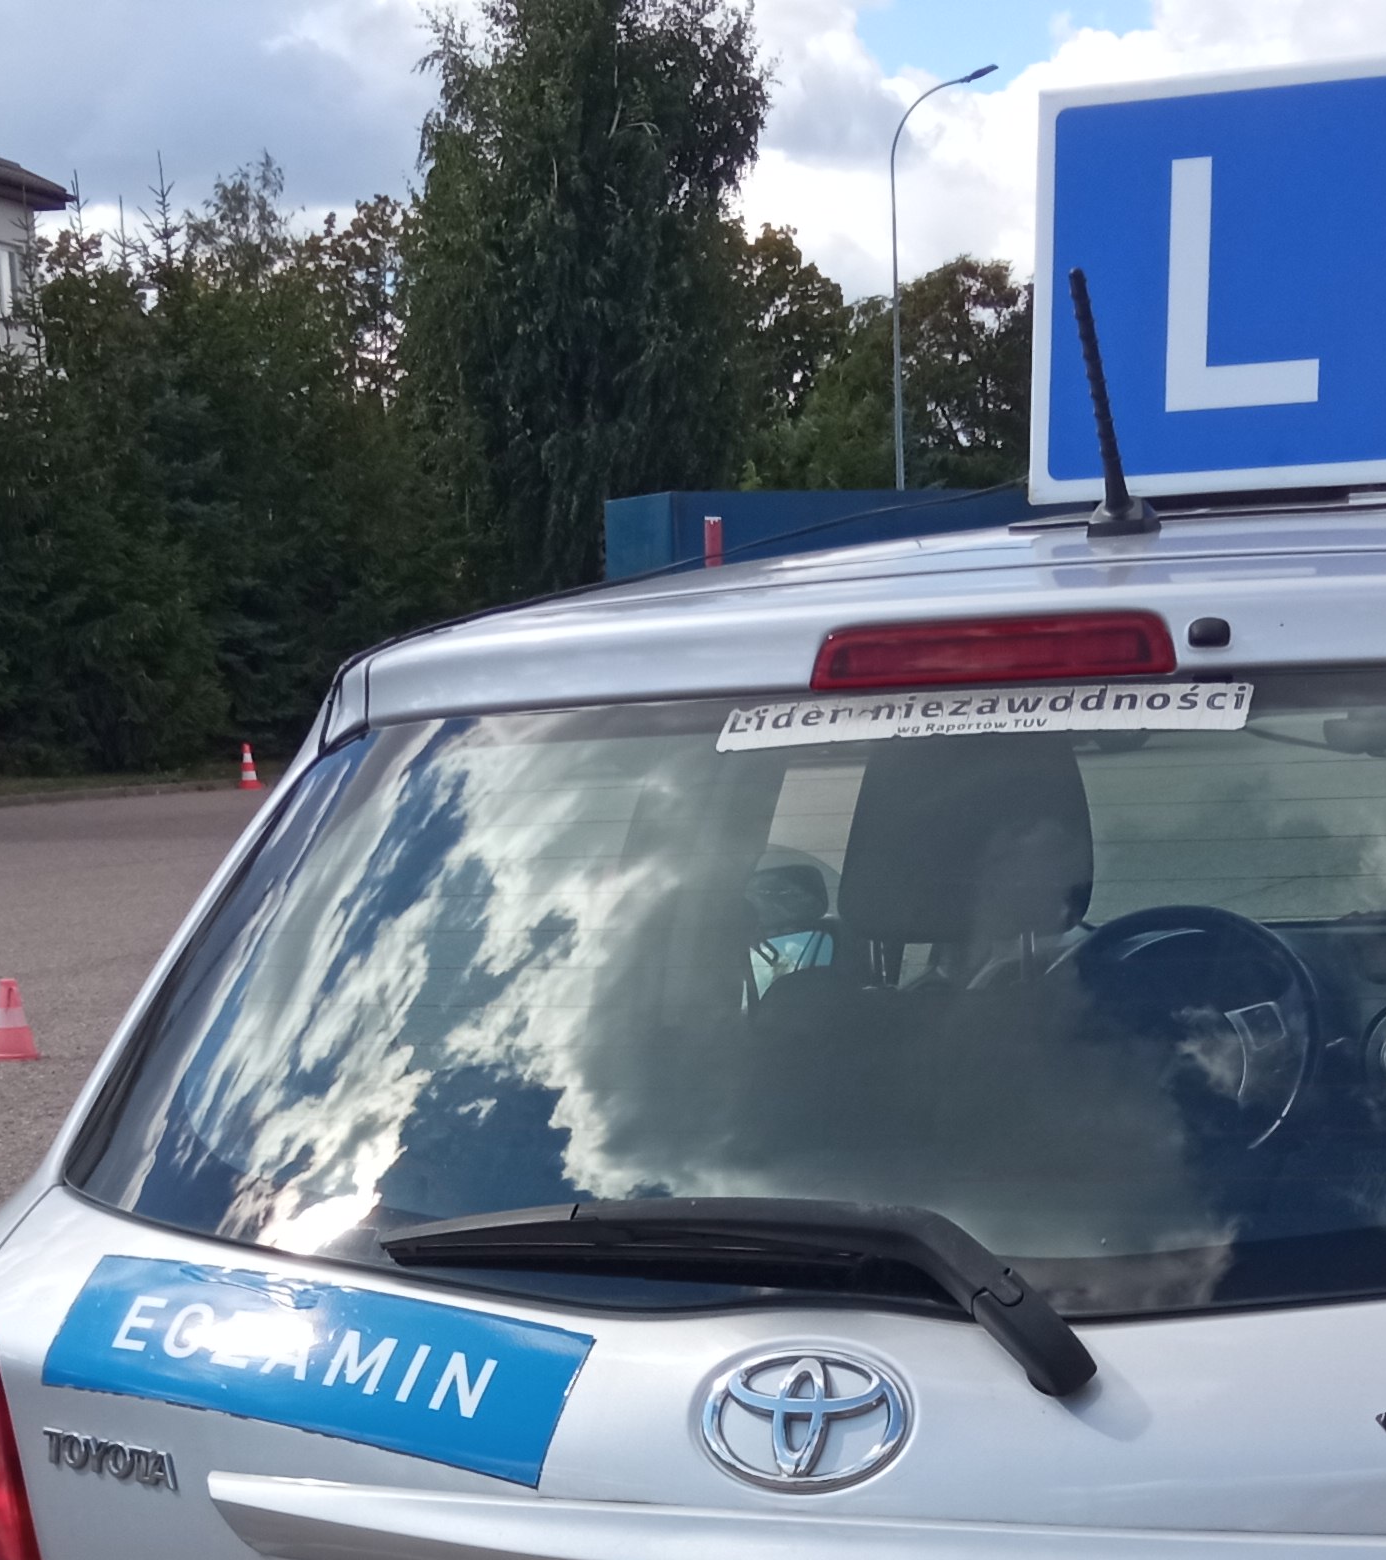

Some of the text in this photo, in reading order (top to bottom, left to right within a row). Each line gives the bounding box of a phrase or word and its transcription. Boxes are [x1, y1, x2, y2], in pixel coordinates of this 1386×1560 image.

[1165, 156, 1320, 413] L
[728, 685, 1247, 734] Lider niezawodności
[43, 1427, 178, 1491] TOYOTA
